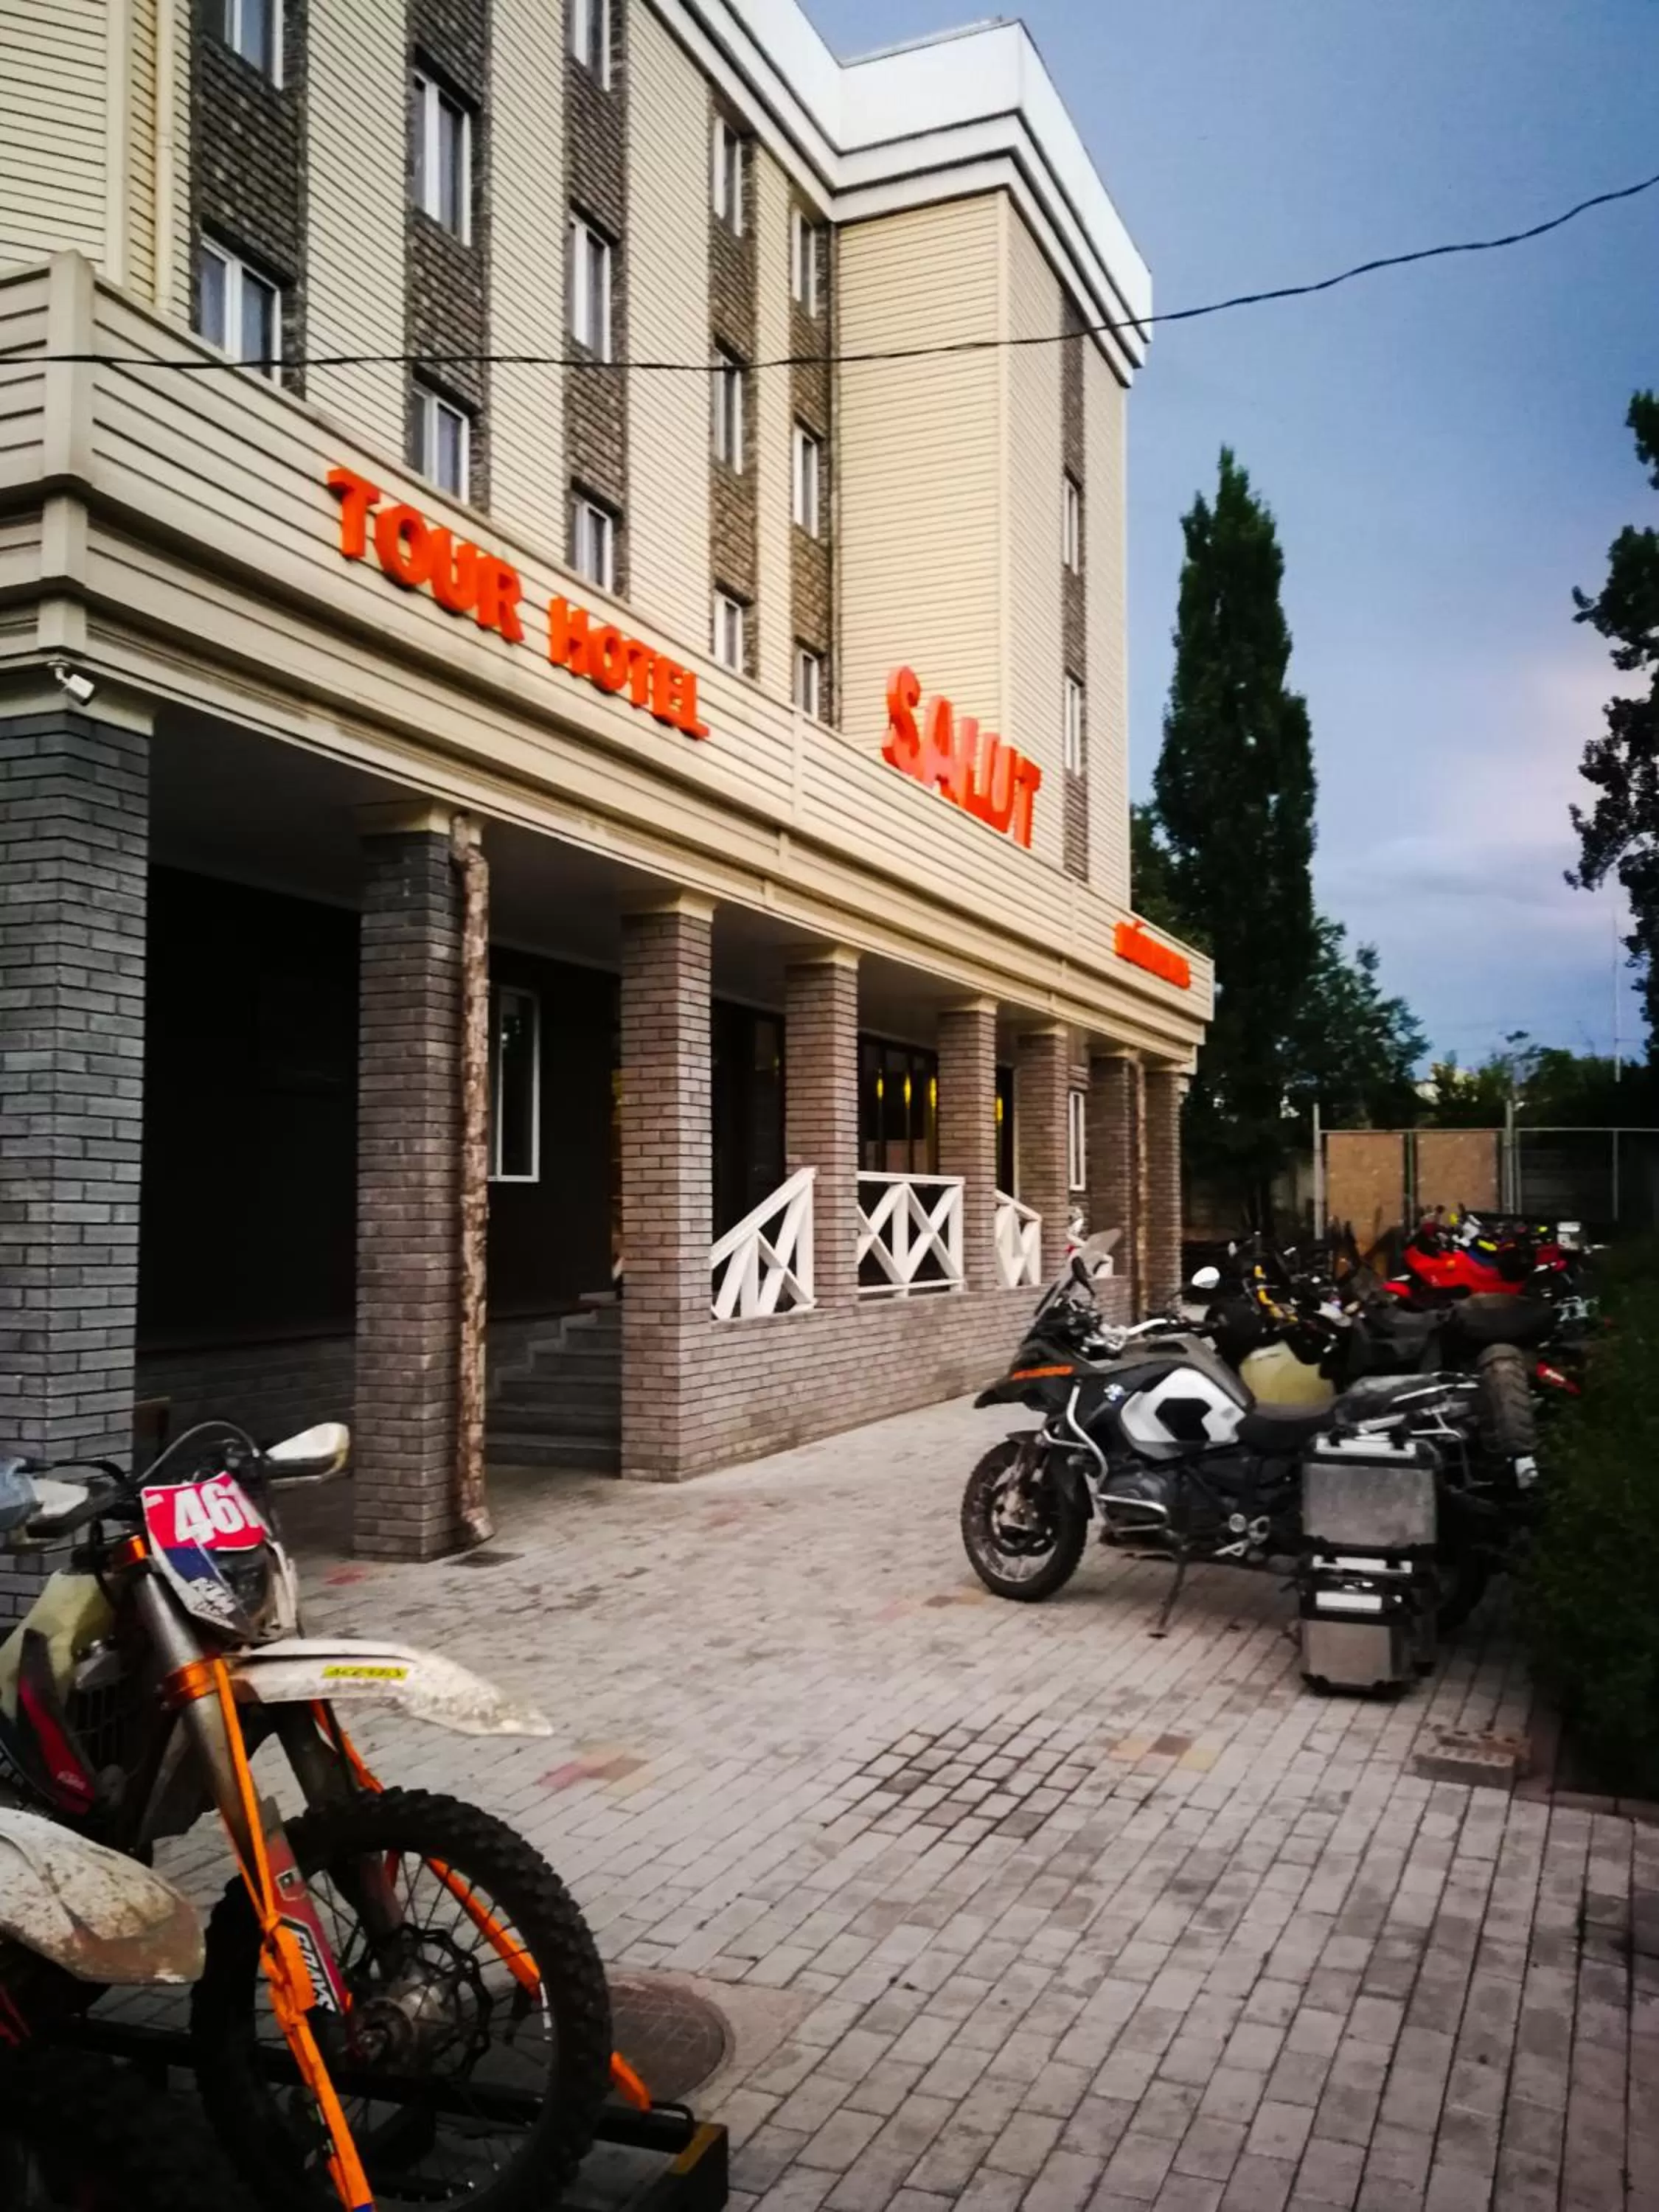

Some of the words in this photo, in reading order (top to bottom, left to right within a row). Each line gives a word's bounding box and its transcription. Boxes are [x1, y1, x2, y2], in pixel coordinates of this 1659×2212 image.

[327, 467, 524, 644] TOUR
[549, 595, 709, 740] HOTEL
[881, 666, 1042, 849] SALUT
